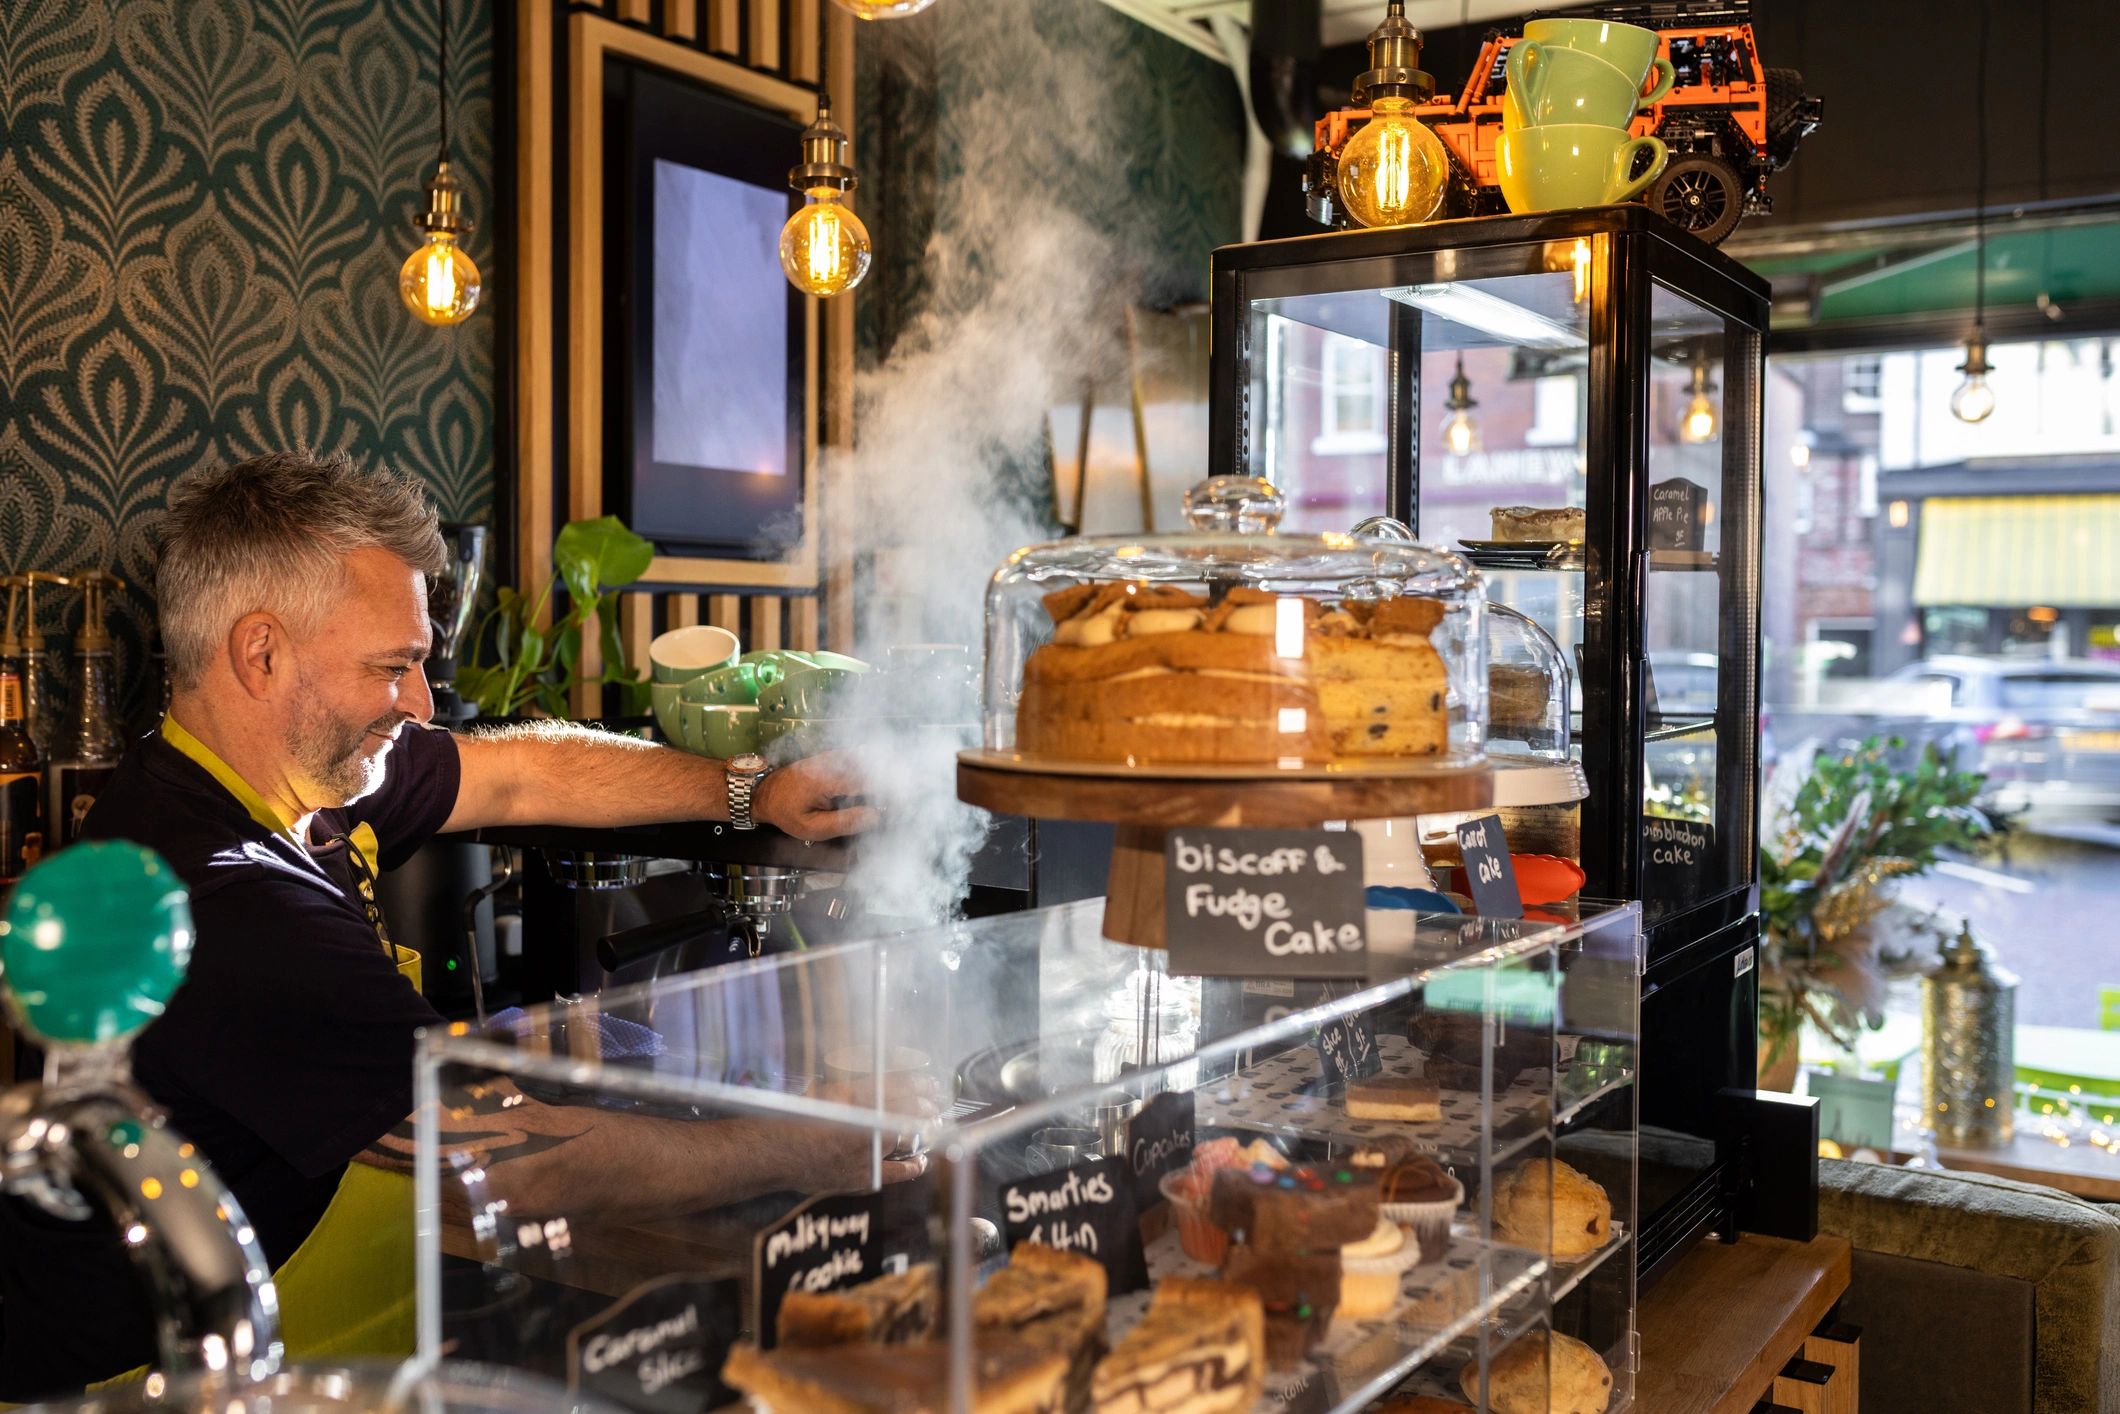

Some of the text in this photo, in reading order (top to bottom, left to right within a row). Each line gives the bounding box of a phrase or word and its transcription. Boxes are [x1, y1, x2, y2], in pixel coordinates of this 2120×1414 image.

[1185, 883, 1293, 931] Fudge
[1264, 919, 1364, 956] Cake
[1133, 1129, 1191, 1176] Cupcakes
[1006, 1170, 1114, 1223] Smarties
